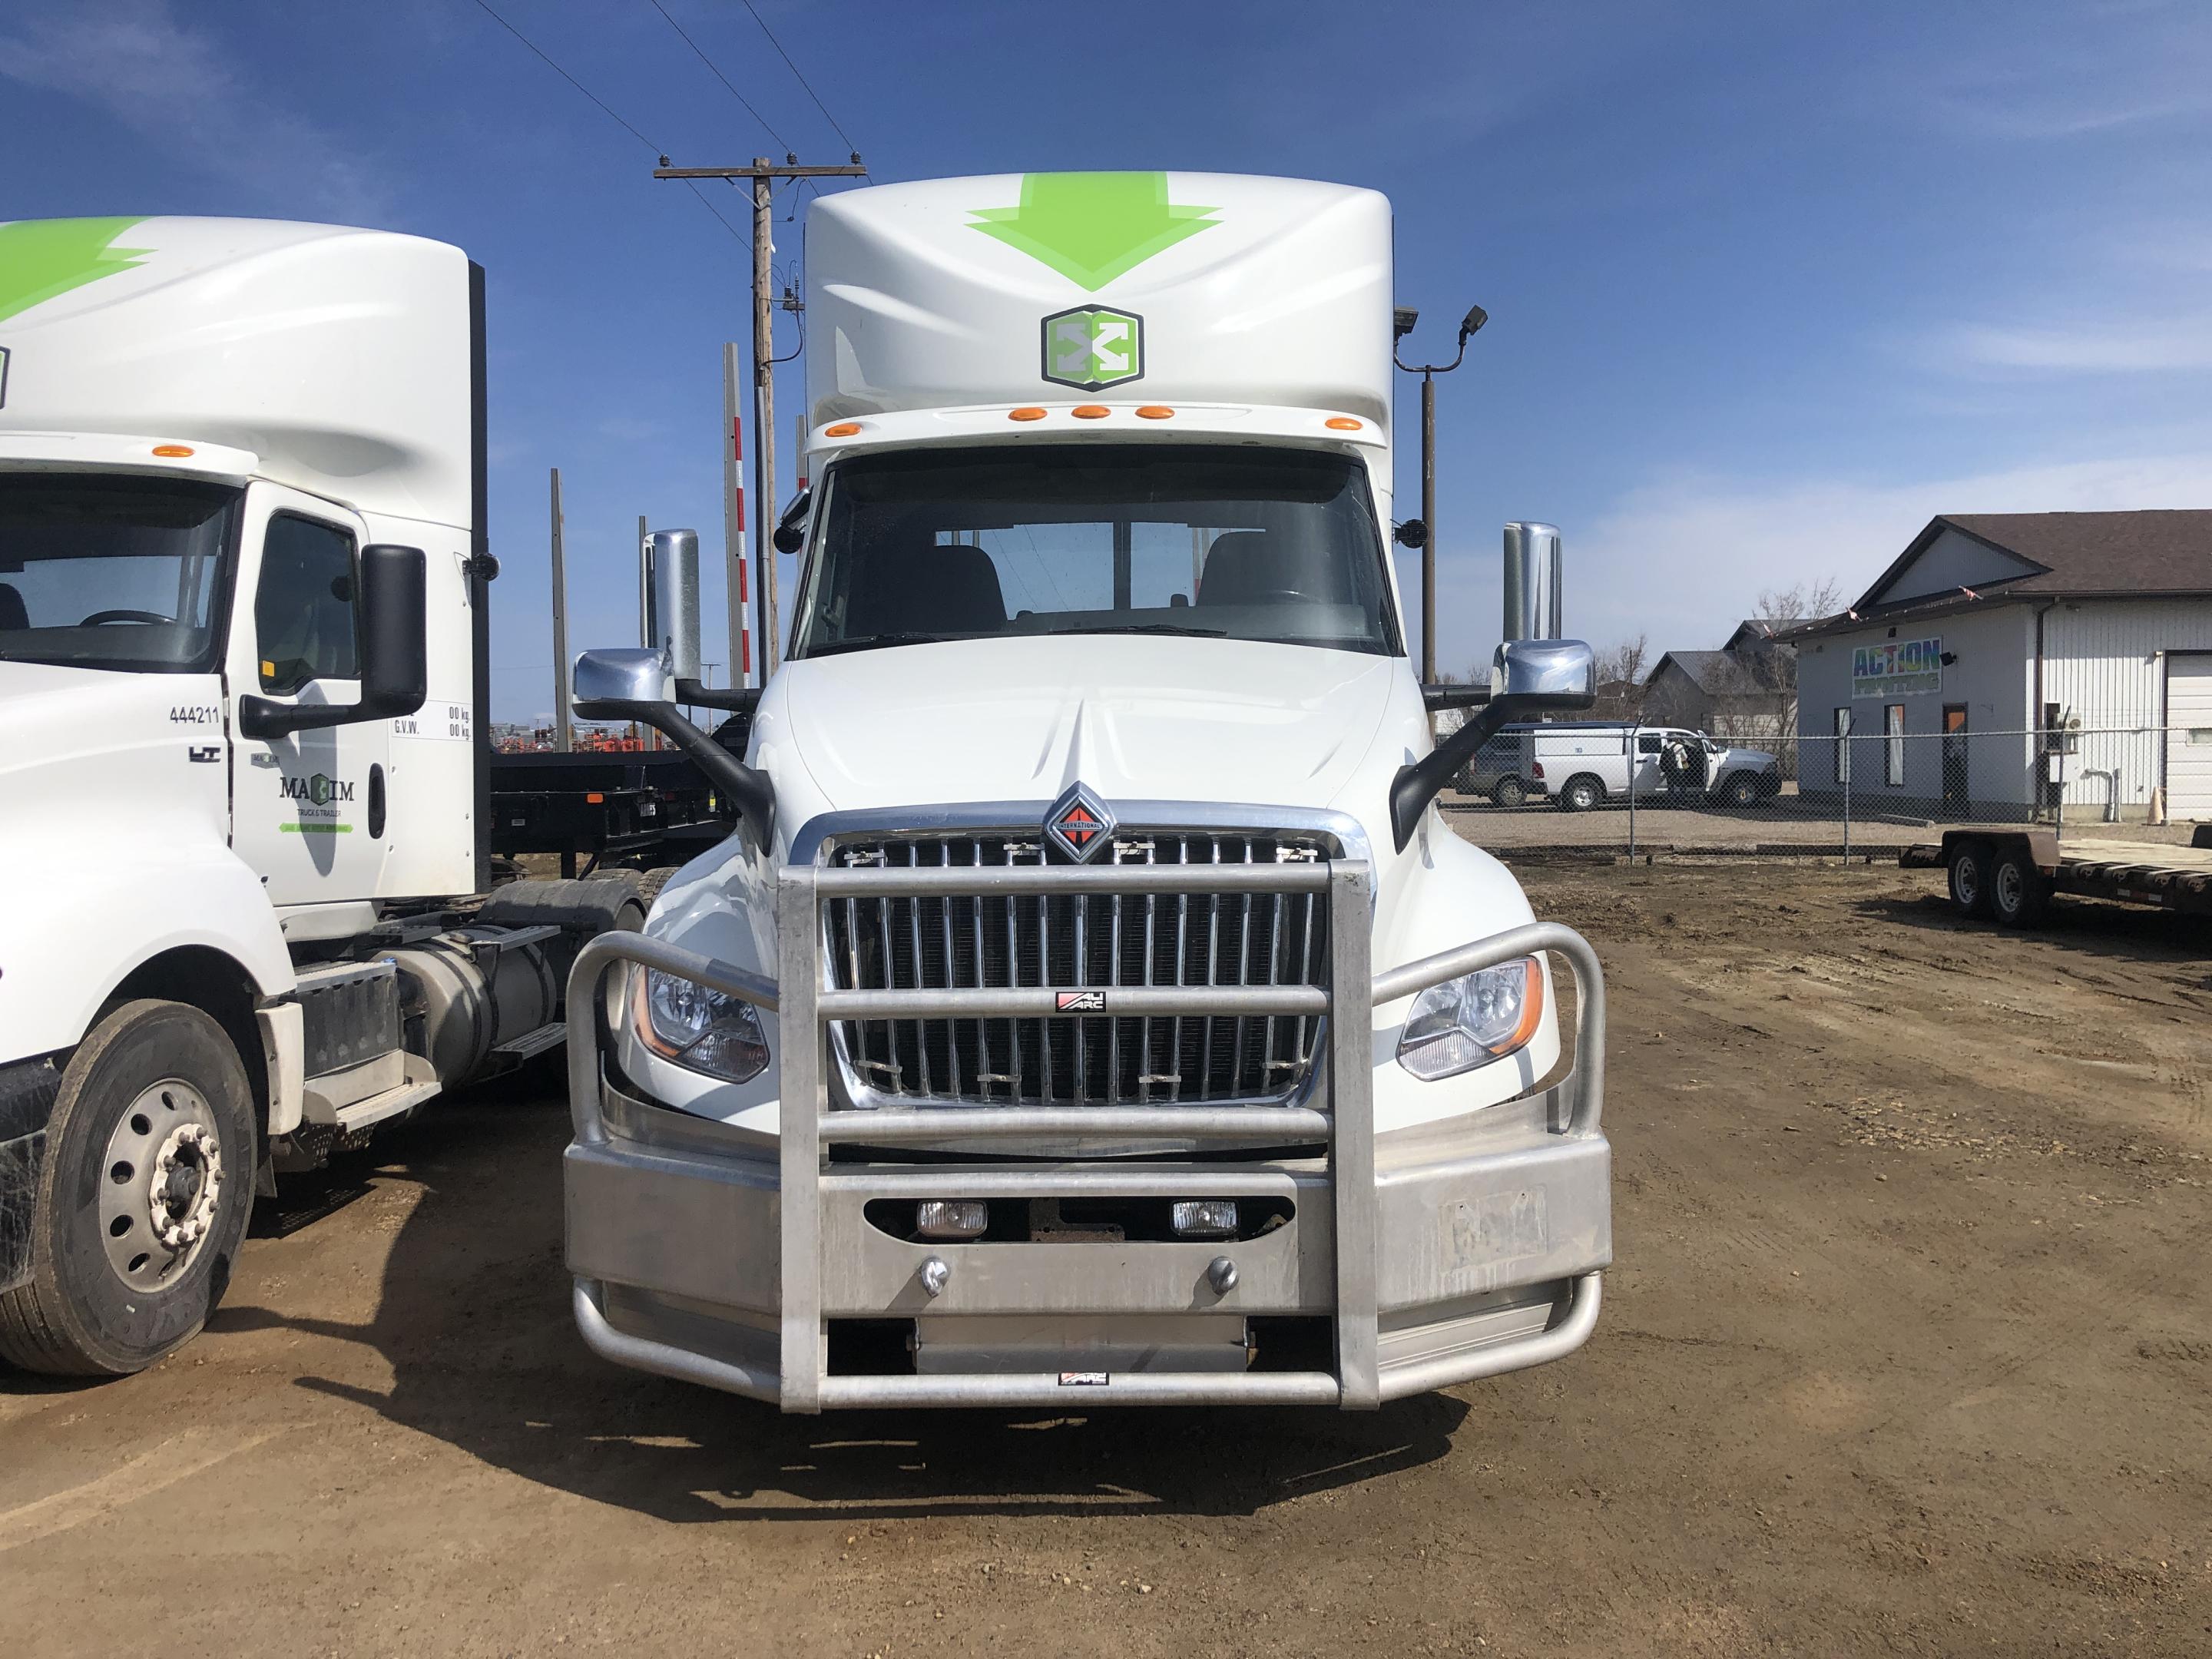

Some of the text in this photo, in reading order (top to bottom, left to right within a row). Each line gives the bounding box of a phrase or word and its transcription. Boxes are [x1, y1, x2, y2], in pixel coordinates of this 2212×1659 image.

[1853, 639, 1940, 676] ACTION
[171, 707, 219, 723] 444211
[449, 707, 459, 719] 00
[395, 720, 419, 734] G.V.W.
[450, 724, 460, 737] 00
[320, 809, 342, 817] TRAILER
[1058, 821, 1100, 830] INTERNATIONAL
[1068, 1001, 1104, 1009] ARC
